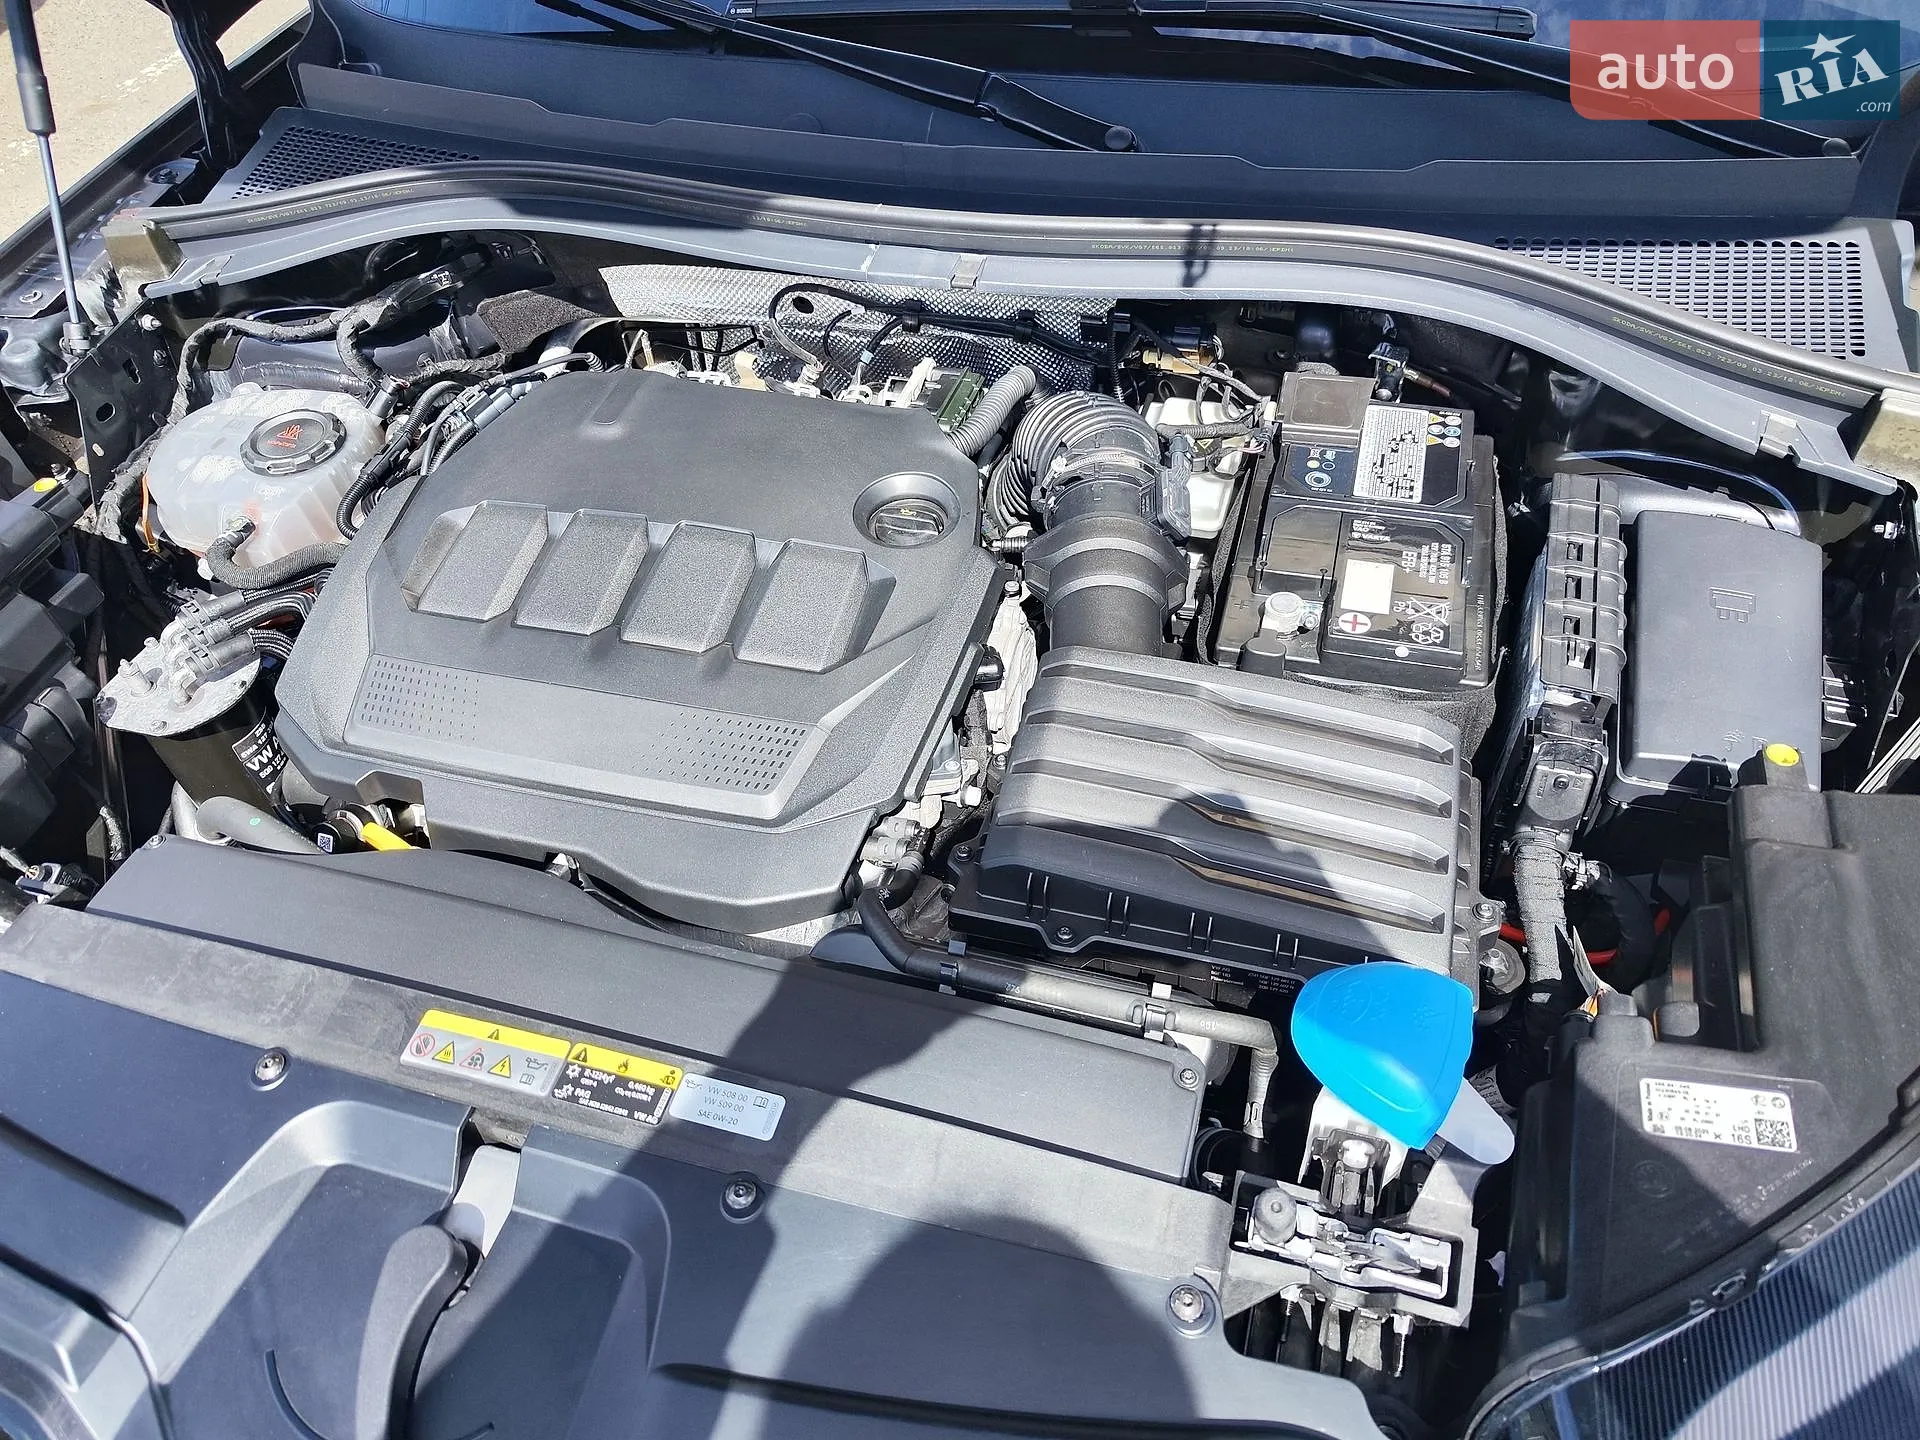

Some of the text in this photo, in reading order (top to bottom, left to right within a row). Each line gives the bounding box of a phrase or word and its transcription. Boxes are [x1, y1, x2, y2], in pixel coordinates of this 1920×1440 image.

[1401, 551, 1418, 574] EFB+
[245, 744, 274, 771] VW
[708, 1085, 749, 1103] VW 508 00
[704, 1096, 745, 1113] VW 509 00
[634, 1110, 647, 1122] VW
[697, 1109, 739, 1126] SAE 0W-20
